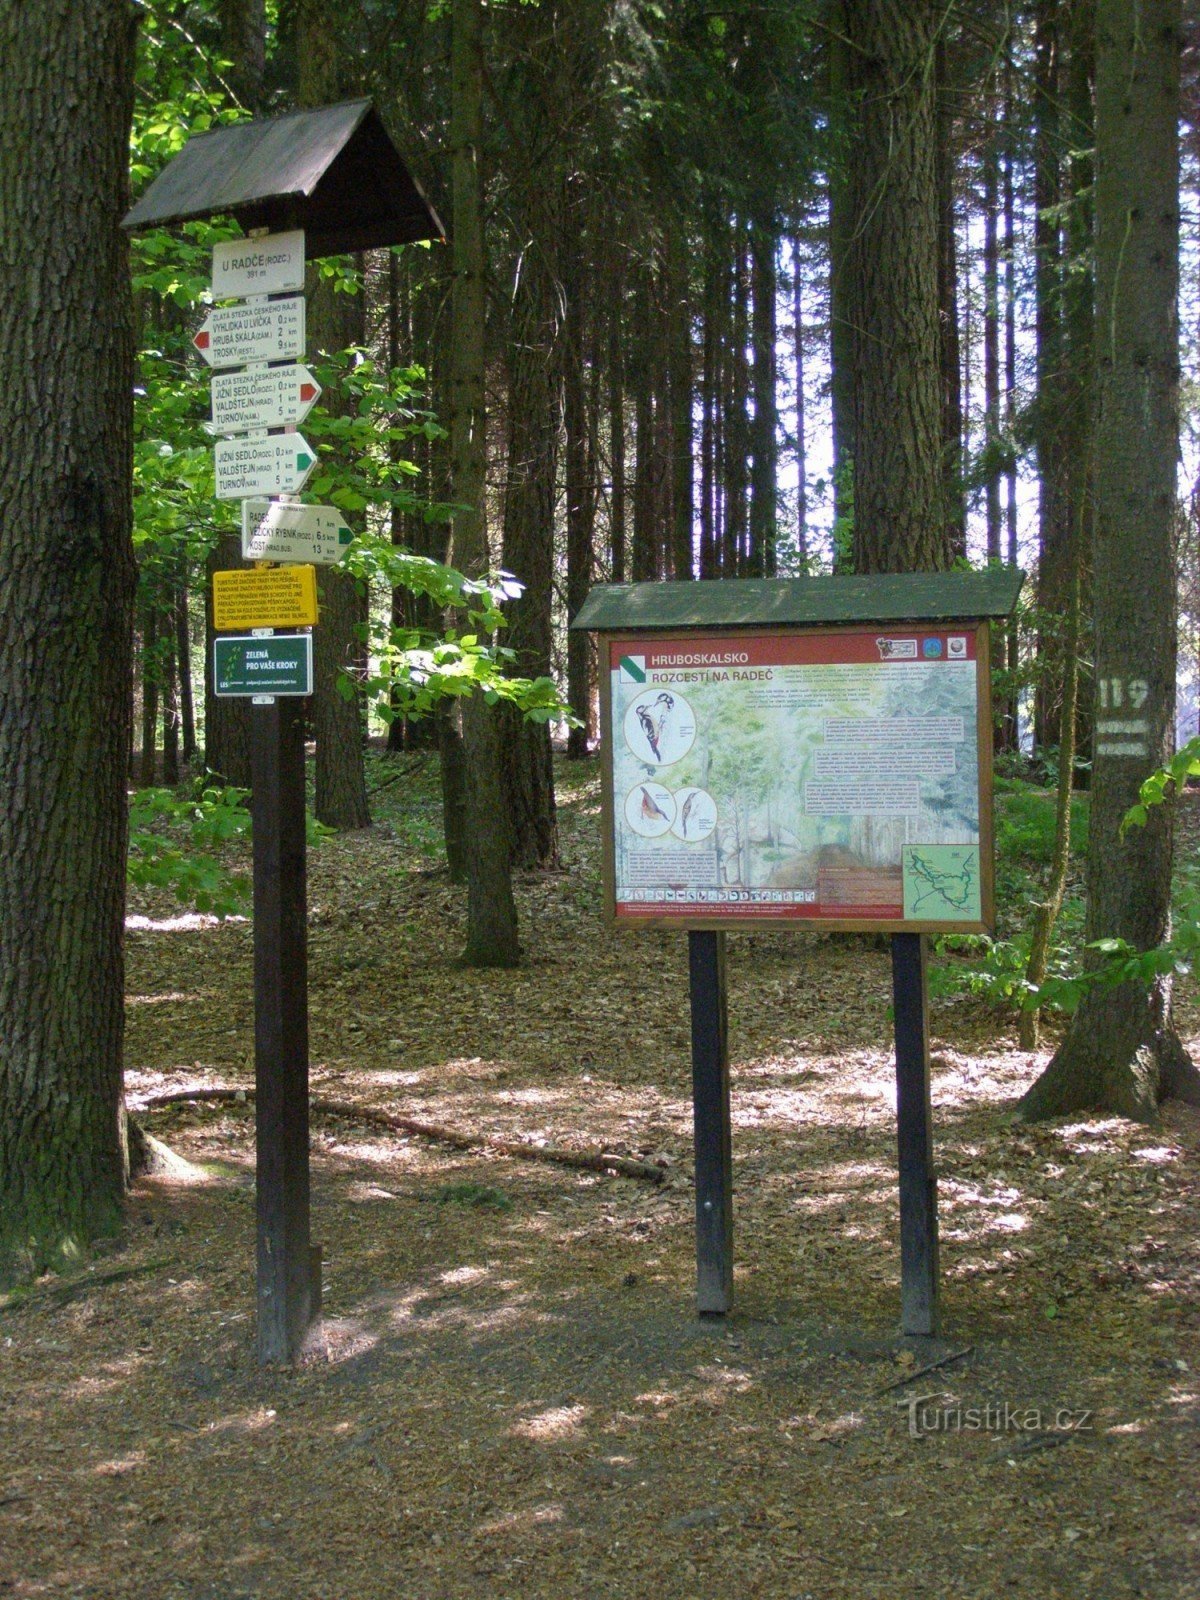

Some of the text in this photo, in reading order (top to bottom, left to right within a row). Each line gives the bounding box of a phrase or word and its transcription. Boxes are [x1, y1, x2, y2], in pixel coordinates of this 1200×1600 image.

[222, 261, 229, 271] U
[231, 253, 265, 270] RADČE
[247, 271, 258, 279] 391
[232, 310, 253, 319] STEZKA
[278, 327, 283, 337] 2
[213, 348, 238, 359] TROSKY
[233, 375, 254, 385] STEZKA
[216, 386, 232, 399] JIŽNÍ
[233, 384, 256, 396] SEDLO
[216, 398, 255, 411] VALDŠTEJN
[216, 411, 244, 424] TURNOV
[278, 407, 283, 416] 5
[235, 449, 257, 461] SEDLO
[218, 463, 256, 476] VALDŠTEJN
[276, 461, 280, 470] 1
[219, 477, 245, 490] TURNOV
[275, 475, 280, 484] 5
[316, 518, 320, 527] 1
[276, 527, 297, 538] RYBNÍK
[249, 541, 265, 552] KOST
[312, 544, 322, 554] 13
[246, 649, 269, 659] ZELENÁ
[651, 652, 749, 665] HRUBOSKALSKO
[246, 660, 298, 670] PRO VAŠE KROKY
[652, 670, 709, 683] ROZCESTÍ
[712, 672, 729, 681] NA
[732, 669, 774, 681] RADEČ
[1100, 678, 1148, 708] 119
